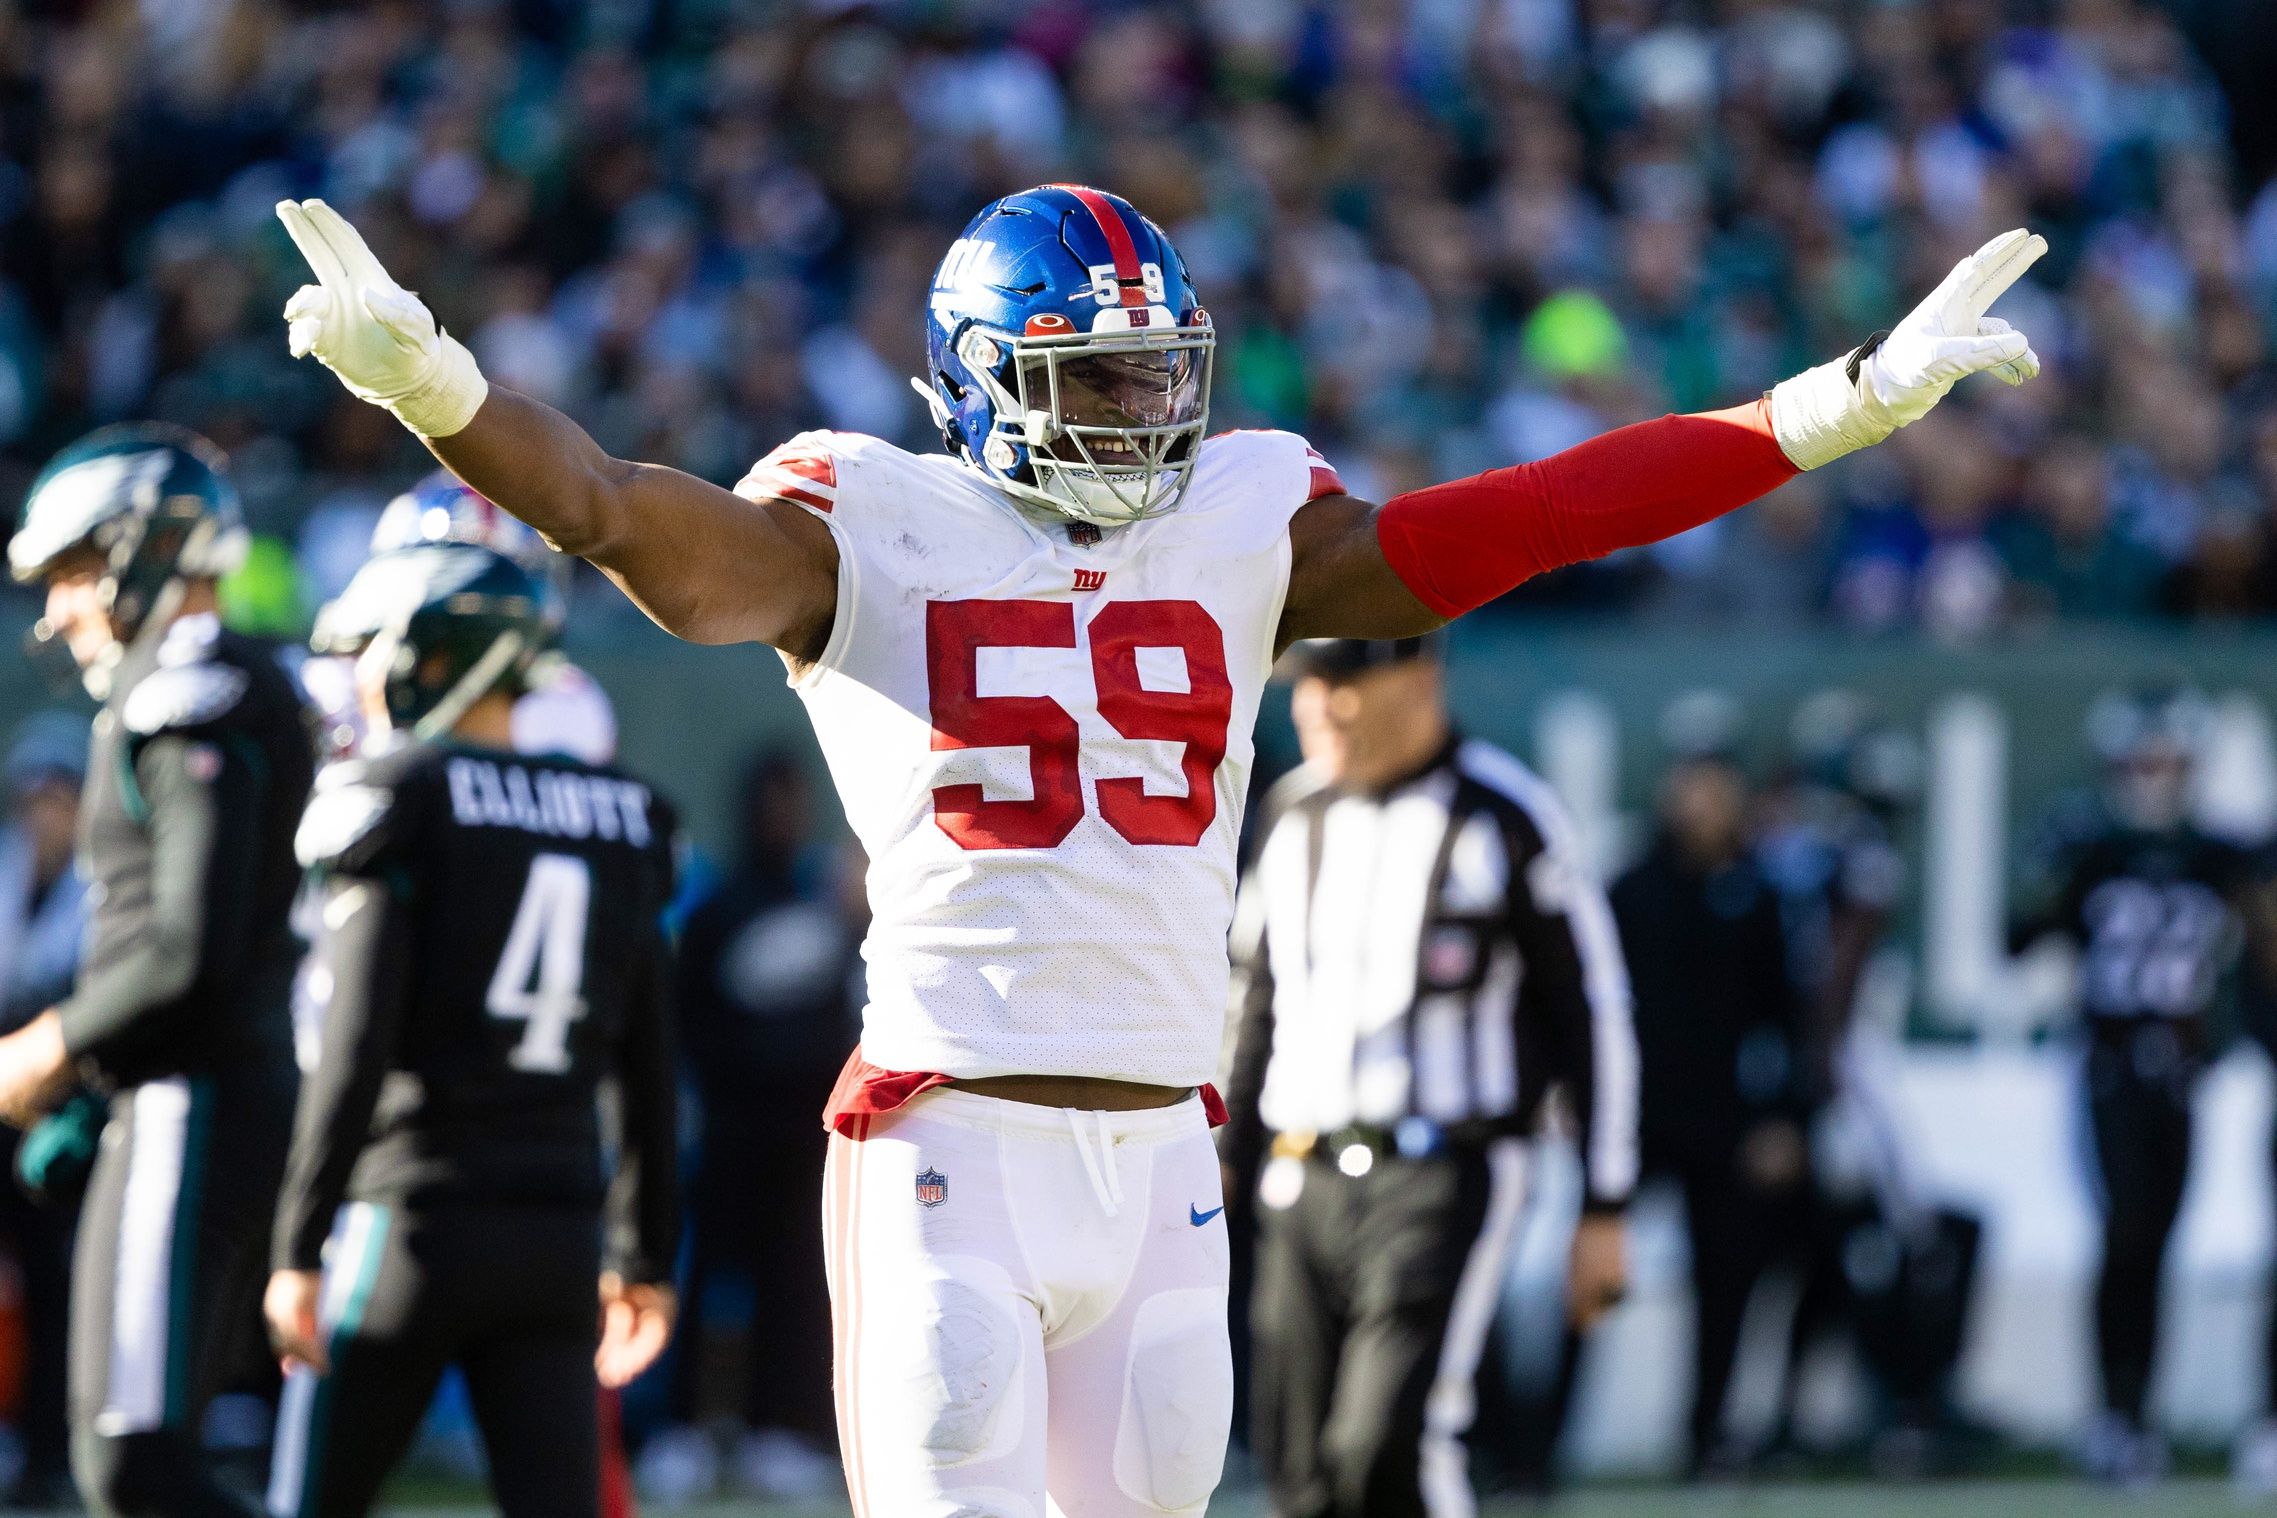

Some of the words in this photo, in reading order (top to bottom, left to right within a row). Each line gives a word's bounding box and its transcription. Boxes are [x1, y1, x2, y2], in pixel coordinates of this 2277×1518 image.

[1088, 262, 1166, 305] 59
[926, 599, 1233, 850] 59
[447, 756, 653, 849] ELLIOTT
[486, 852, 591, 1075] 4
[919, 1185, 942, 1201] NFL
